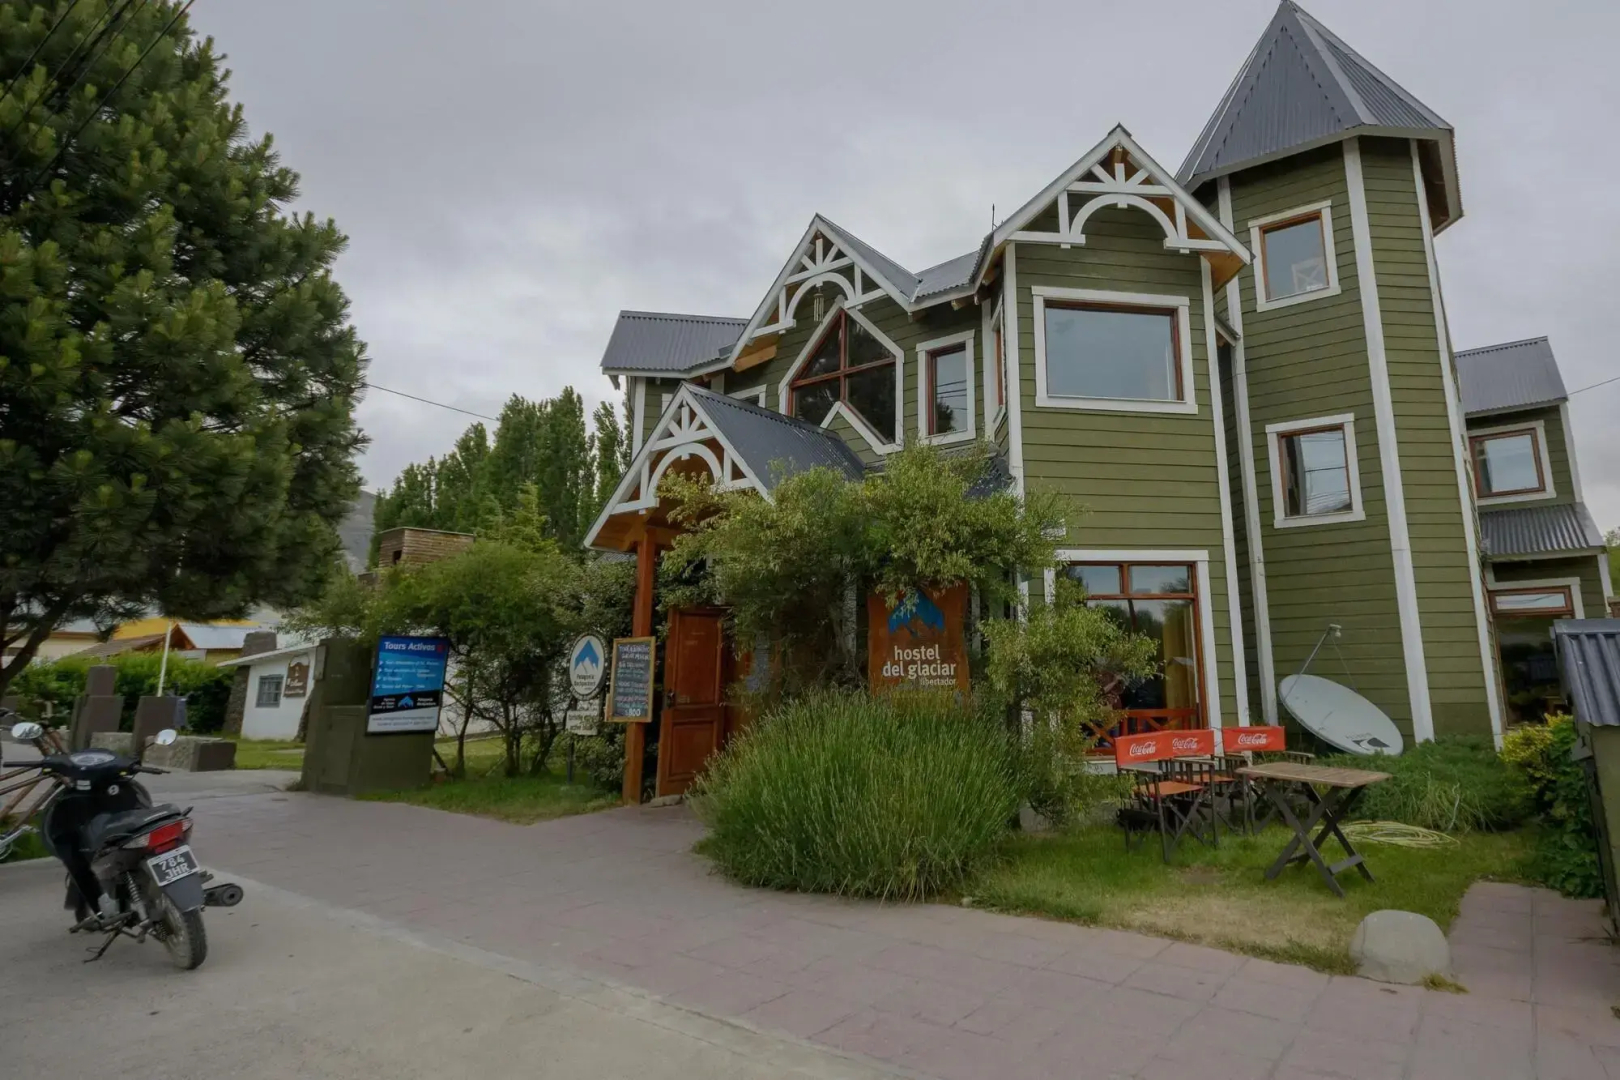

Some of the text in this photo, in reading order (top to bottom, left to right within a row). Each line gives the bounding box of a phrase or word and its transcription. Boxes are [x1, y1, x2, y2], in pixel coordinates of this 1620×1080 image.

[384, 641, 406, 650] Tours
[894, 644, 940, 660] hostel
[882, 660, 957, 680] del glaciar
[158, 855, 185, 871] 784
[165, 862, 190, 879] JHR
